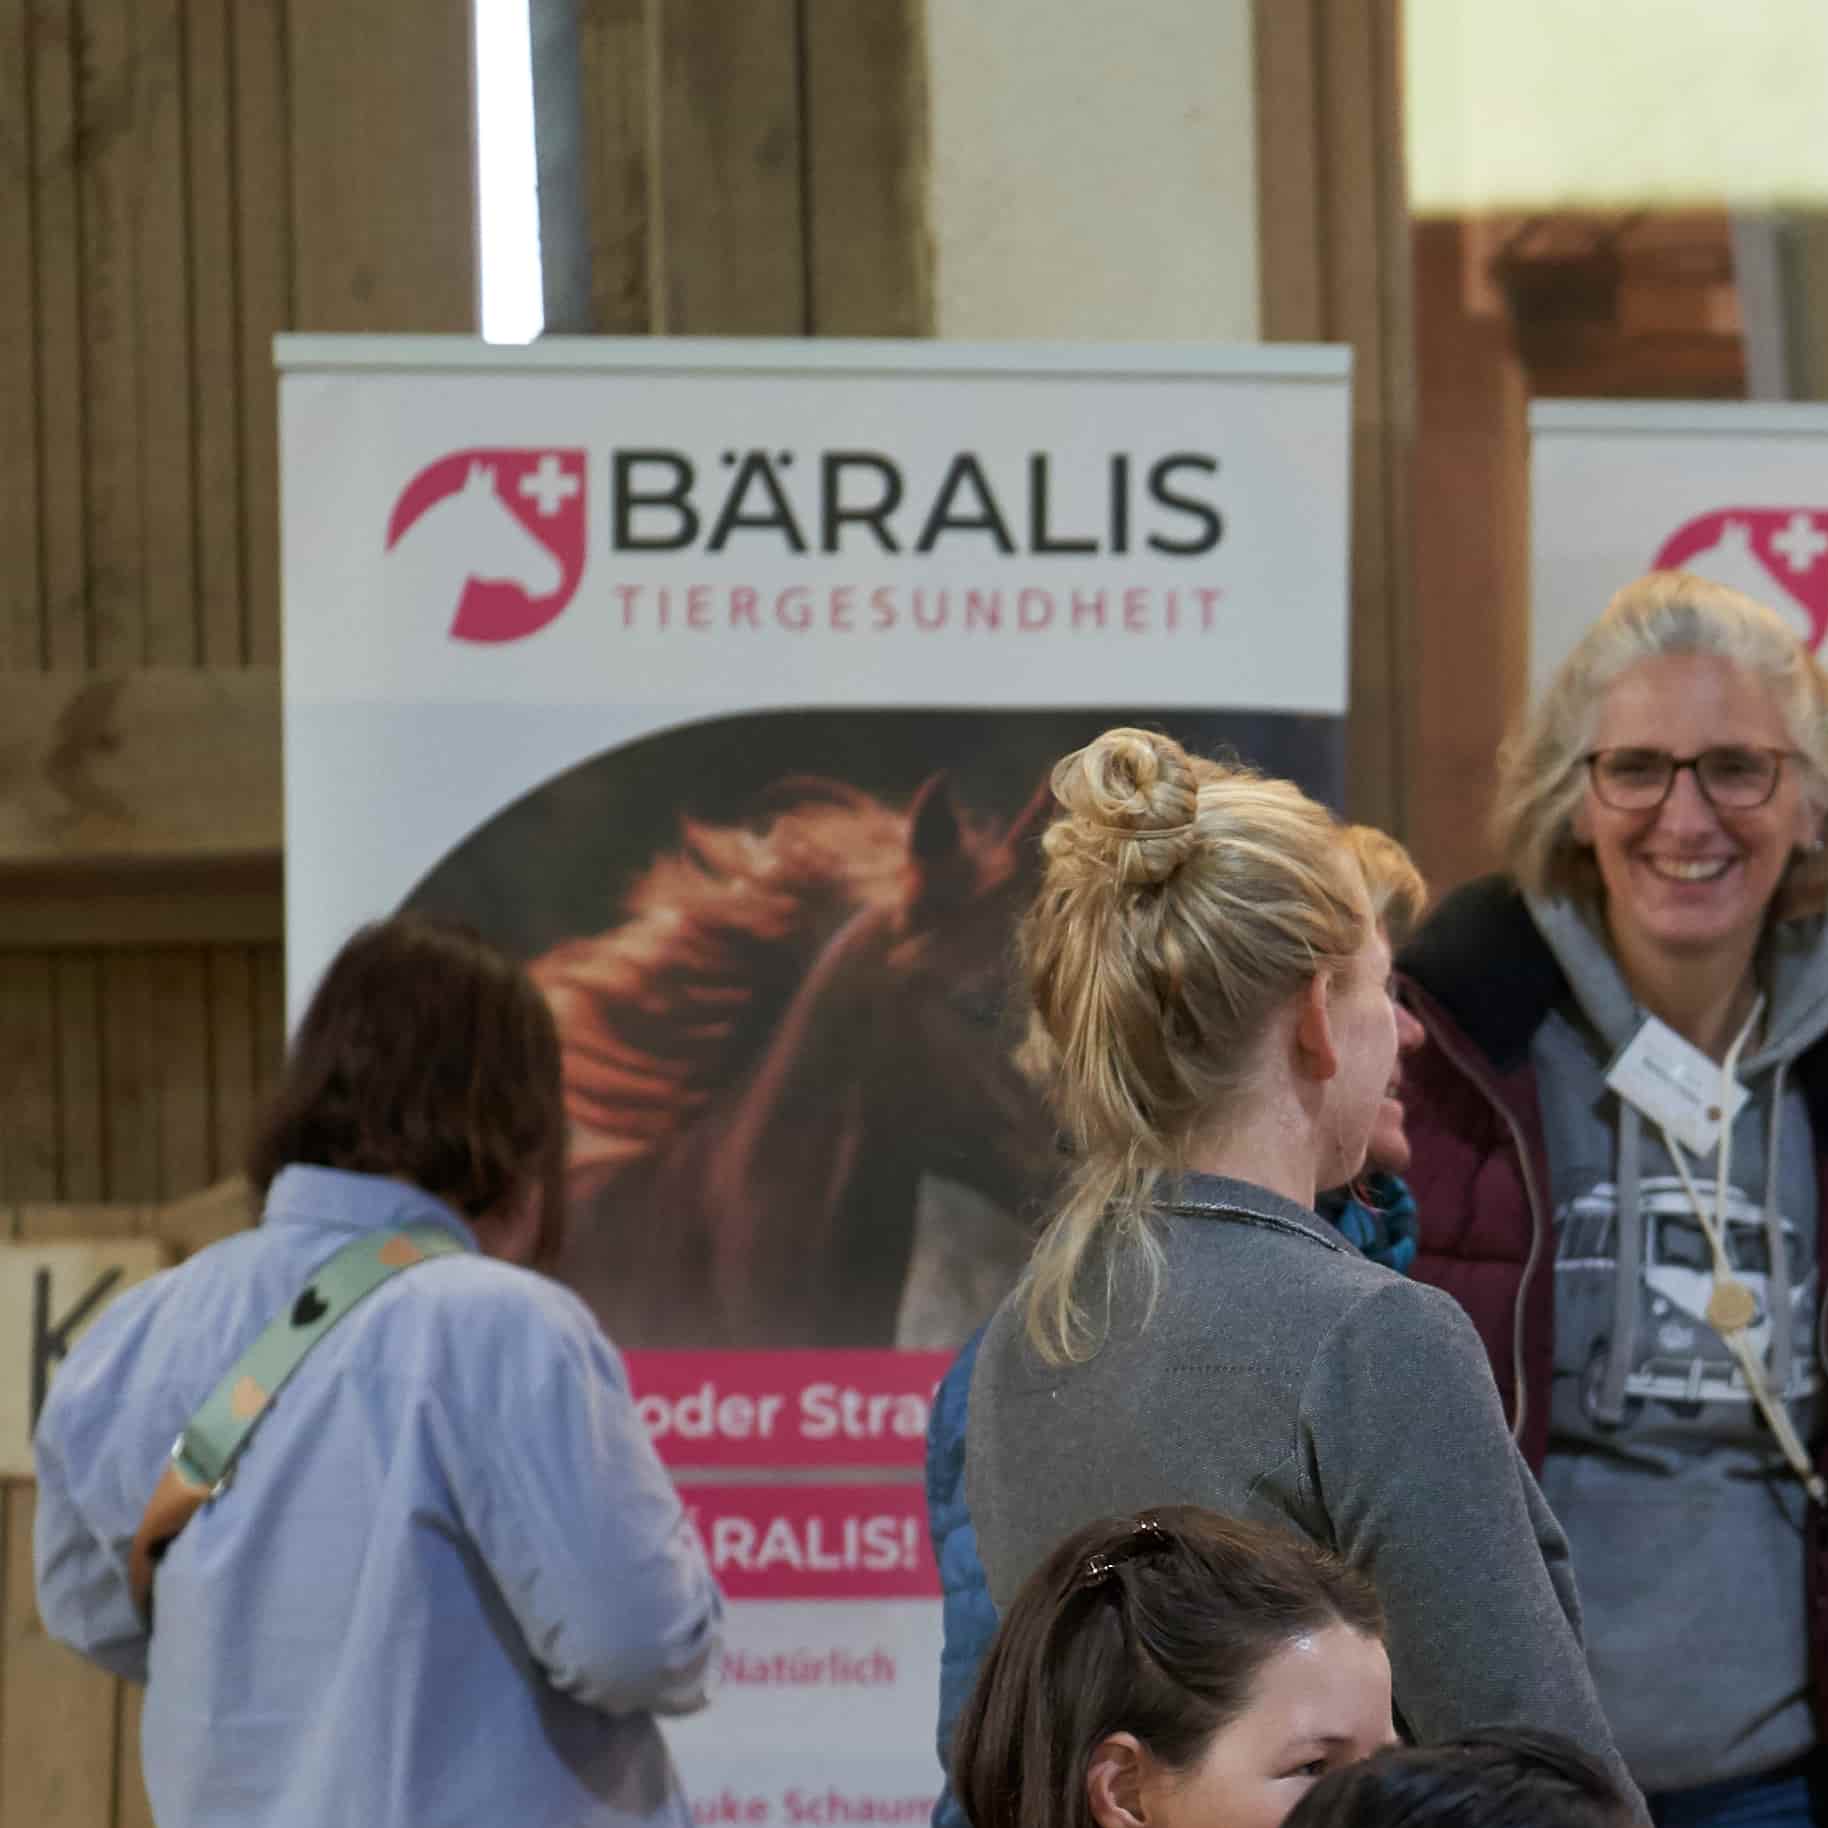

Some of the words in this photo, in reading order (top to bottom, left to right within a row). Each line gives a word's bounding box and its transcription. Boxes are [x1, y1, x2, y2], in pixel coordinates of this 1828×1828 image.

[612, 447, 1224, 556] BÄRALIS
[615, 586, 1225, 635] TIERGESUNDHEIT
[638, 1381, 783, 1440] oder
[799, 1381, 941, 1440] Stra
[721, 1652, 897, 1685] Natürlich
